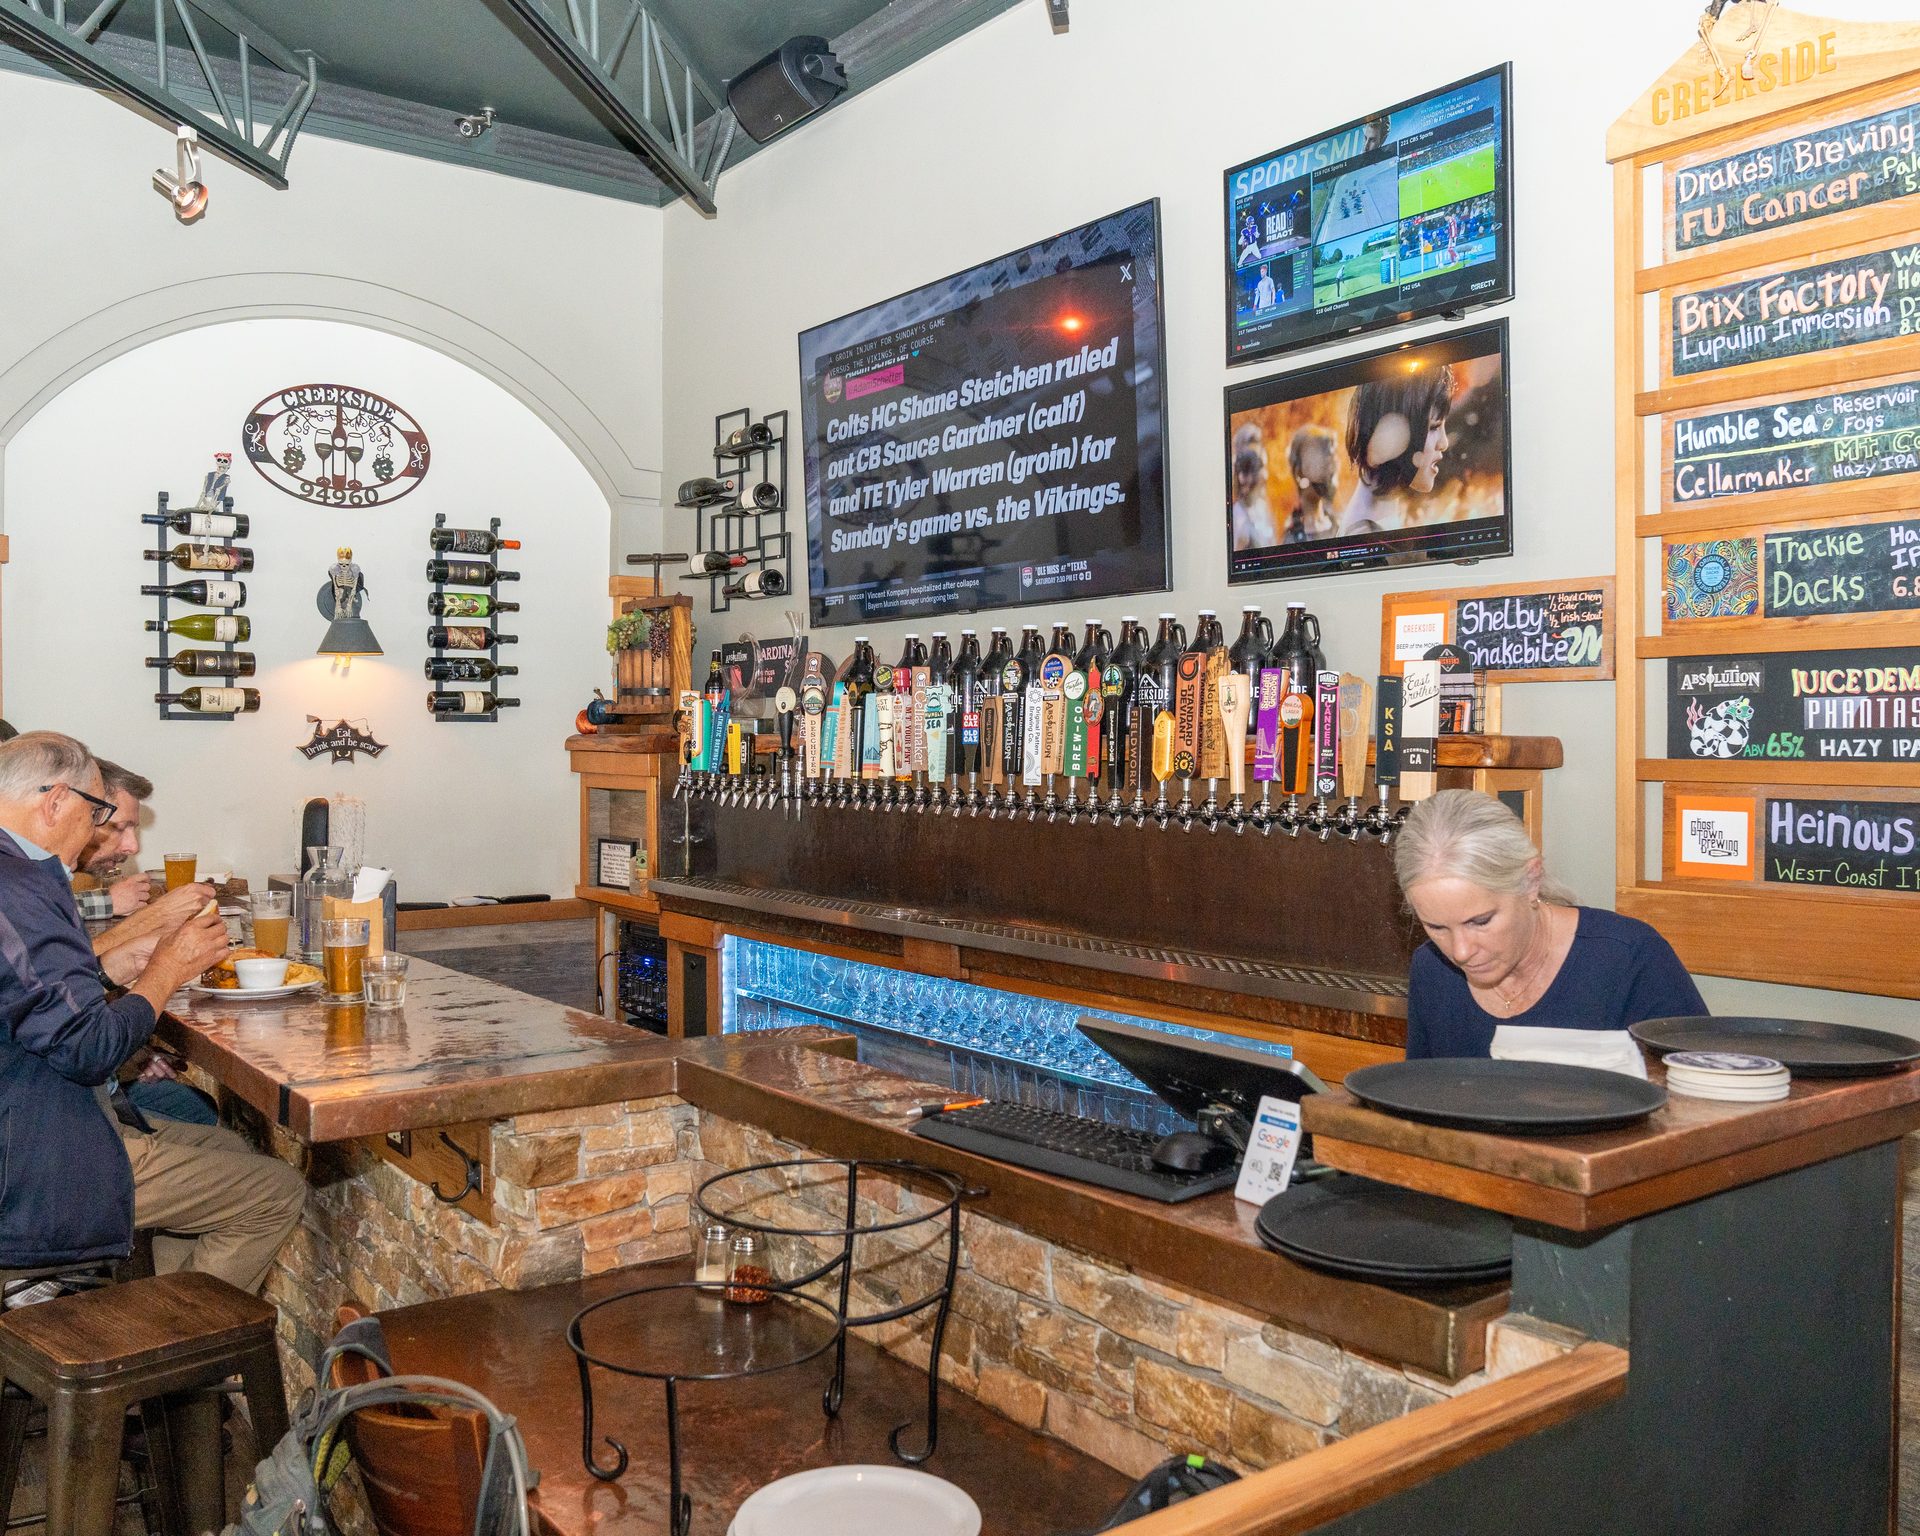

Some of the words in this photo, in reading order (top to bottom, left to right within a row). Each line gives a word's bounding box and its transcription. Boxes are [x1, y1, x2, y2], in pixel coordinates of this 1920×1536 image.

[1678, 154, 1773, 203] Drake's
[1794, 122, 1914, 173] Brewing
[1682, 201, 1725, 243] FU
[1743, 171, 1870, 226] Cancer
[1266, 211, 1286, 235] READ
[1266, 228, 1294, 242] REACT
[1470, 279, 1496, 291] DIRECTV
[1679, 293, 1745, 336] Brix
[1760, 269, 1891, 320] Factory
[835, 351, 853, 362] GROIN
[856, 341, 878, 355] INJURY
[880, 336, 892, 347] FOR
[895, 324, 926, 341] SUNDAY'S
[929, 317, 945, 330] GAME
[1682, 322, 1766, 363] Lupulin
[1772, 305, 1891, 342] Immersion
[829, 363, 850, 377] VERSUS
[853, 358, 863, 368] THE
[899, 344, 907, 353] OF
[827, 413, 869, 443] Colts
[871, 401, 898, 432] HC
[898, 389, 958, 424] Shane
[960, 362, 1053, 407] Steichen
[1055, 336, 1119, 382] ruled
[281, 387, 396, 422] CREEKSIDE
[1677, 413, 1760, 455] Humble
[1773, 406, 1819, 439] Sea
[1833, 388, 1919, 414] Reservoir
[1843, 415, 1885, 435] Fogs
[827, 453, 856, 480] out
[856, 445, 881, 473] CB
[882, 435, 940, 467] Sauce
[942, 413, 1025, 452] Gardner
[1028, 389, 1086, 434] (calf)
[829, 487, 861, 517] and
[863, 483, 884, 509] TE
[886, 476, 930, 508] Tyler
[932, 460, 1005, 495] Warren
[1007, 436, 1078, 484] (groin)
[1081, 435, 1116, 465] for
[1676, 458, 1815, 499] Cellarmaker
[1832, 463, 1876, 478] Hazy
[1880, 454, 1918, 471] IPA
[300, 481, 379, 506] 94960
[830, 517, 907, 553] Sunday's
[908, 511, 962, 544] game
[965, 506, 993, 529] vs.
[996, 495, 1031, 524] the
[1034, 481, 1126, 517] Vikings.
[1766, 532, 1864, 564] Trackie
[1890, 526, 1920, 546] Ha
[1071, 561, 1087, 571] TEXAS
[867, 591, 886, 600] Vincent
[886, 587, 910, 599] Kompany
[910, 583, 942, 595] hospitalized
[942, 581, 956, 591] after
[957, 579, 980, 590] collapse
[1035, 576, 1056, 585] SATURDAY
[1773, 570, 1865, 609] Dacks
[825, 595, 844, 606] ESPN
[849, 593, 864, 601] SOCCER
[867, 600, 883, 610] Bayern
[883, 599, 900, 608] Munich
[900, 597, 920, 607] manager
[920, 594, 947, 605] undergoing
[947, 592, 959, 601] tests
[1557, 593, 1577, 602] Hard
[1557, 602, 1579, 610] Cider
[1561, 611, 1580, 623] Irish
[1581, 609, 1603, 622] Stout
[1403, 624, 1436, 633] CREEKSIDE
[1463, 632, 1569, 666] Snakebite
[1404, 673, 1430, 691] East
[1681, 665, 1761, 692] ABSOLUTION
[1321, 693, 1336, 703] FU
[715, 715, 724, 737] ATHLETIC
[926, 720, 941, 729] SEA
[1179, 689, 1187, 742] DEVIANT
[1185, 684, 1195, 747] STANDARD
[1324, 700, 1332, 747] CANCER
[336, 728, 352, 738] Eat
[914, 691, 927, 765] Cellarmaker
[1004, 703, 1015, 760] ABSOLUTION
[1384, 707, 1395, 752] KSA
[306, 741, 329, 756] Drink
[330, 738, 345, 747] and
[347, 738, 358, 747] be
[360, 742, 381, 755] scary
[713, 738, 721, 761] BREWING
[1130, 710, 1139, 787] FIELDWORK
[1743, 744, 1765, 757] ABV
[1820, 739, 1882, 757] HAZY
[1409, 754, 1422, 765] CA
[1697, 830, 1723, 845] Town
[1771, 801, 1914, 855] Heinous
[1701, 839, 1738, 857] Brewing
[1258, 1128, 1290, 1149] Google
